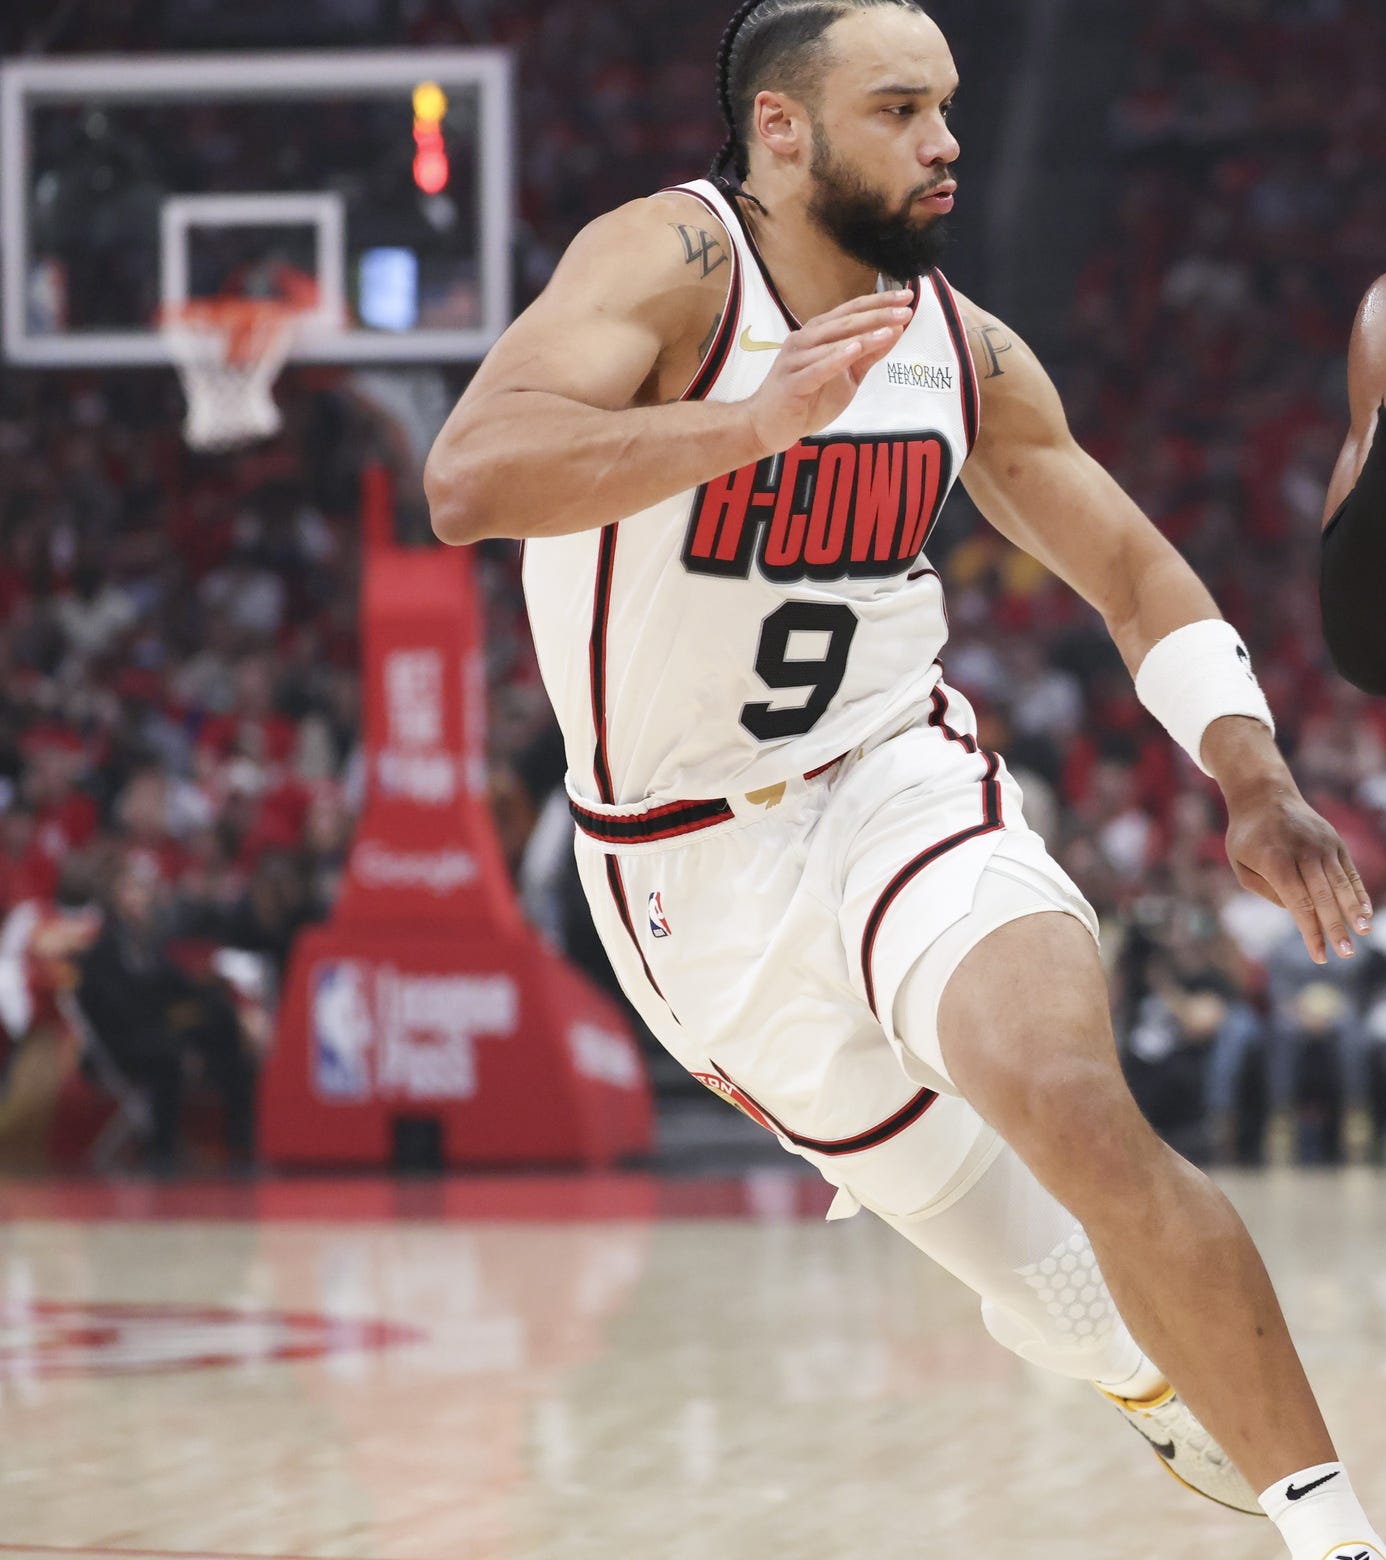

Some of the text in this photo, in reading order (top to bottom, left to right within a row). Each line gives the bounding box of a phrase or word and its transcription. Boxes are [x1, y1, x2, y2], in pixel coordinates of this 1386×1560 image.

[887, 361, 952, 380] MEMORIAL
[888, 372, 953, 390] HERMANN
[681, 430, 953, 583] H-TOWN
[738, 598, 861, 743] 9
